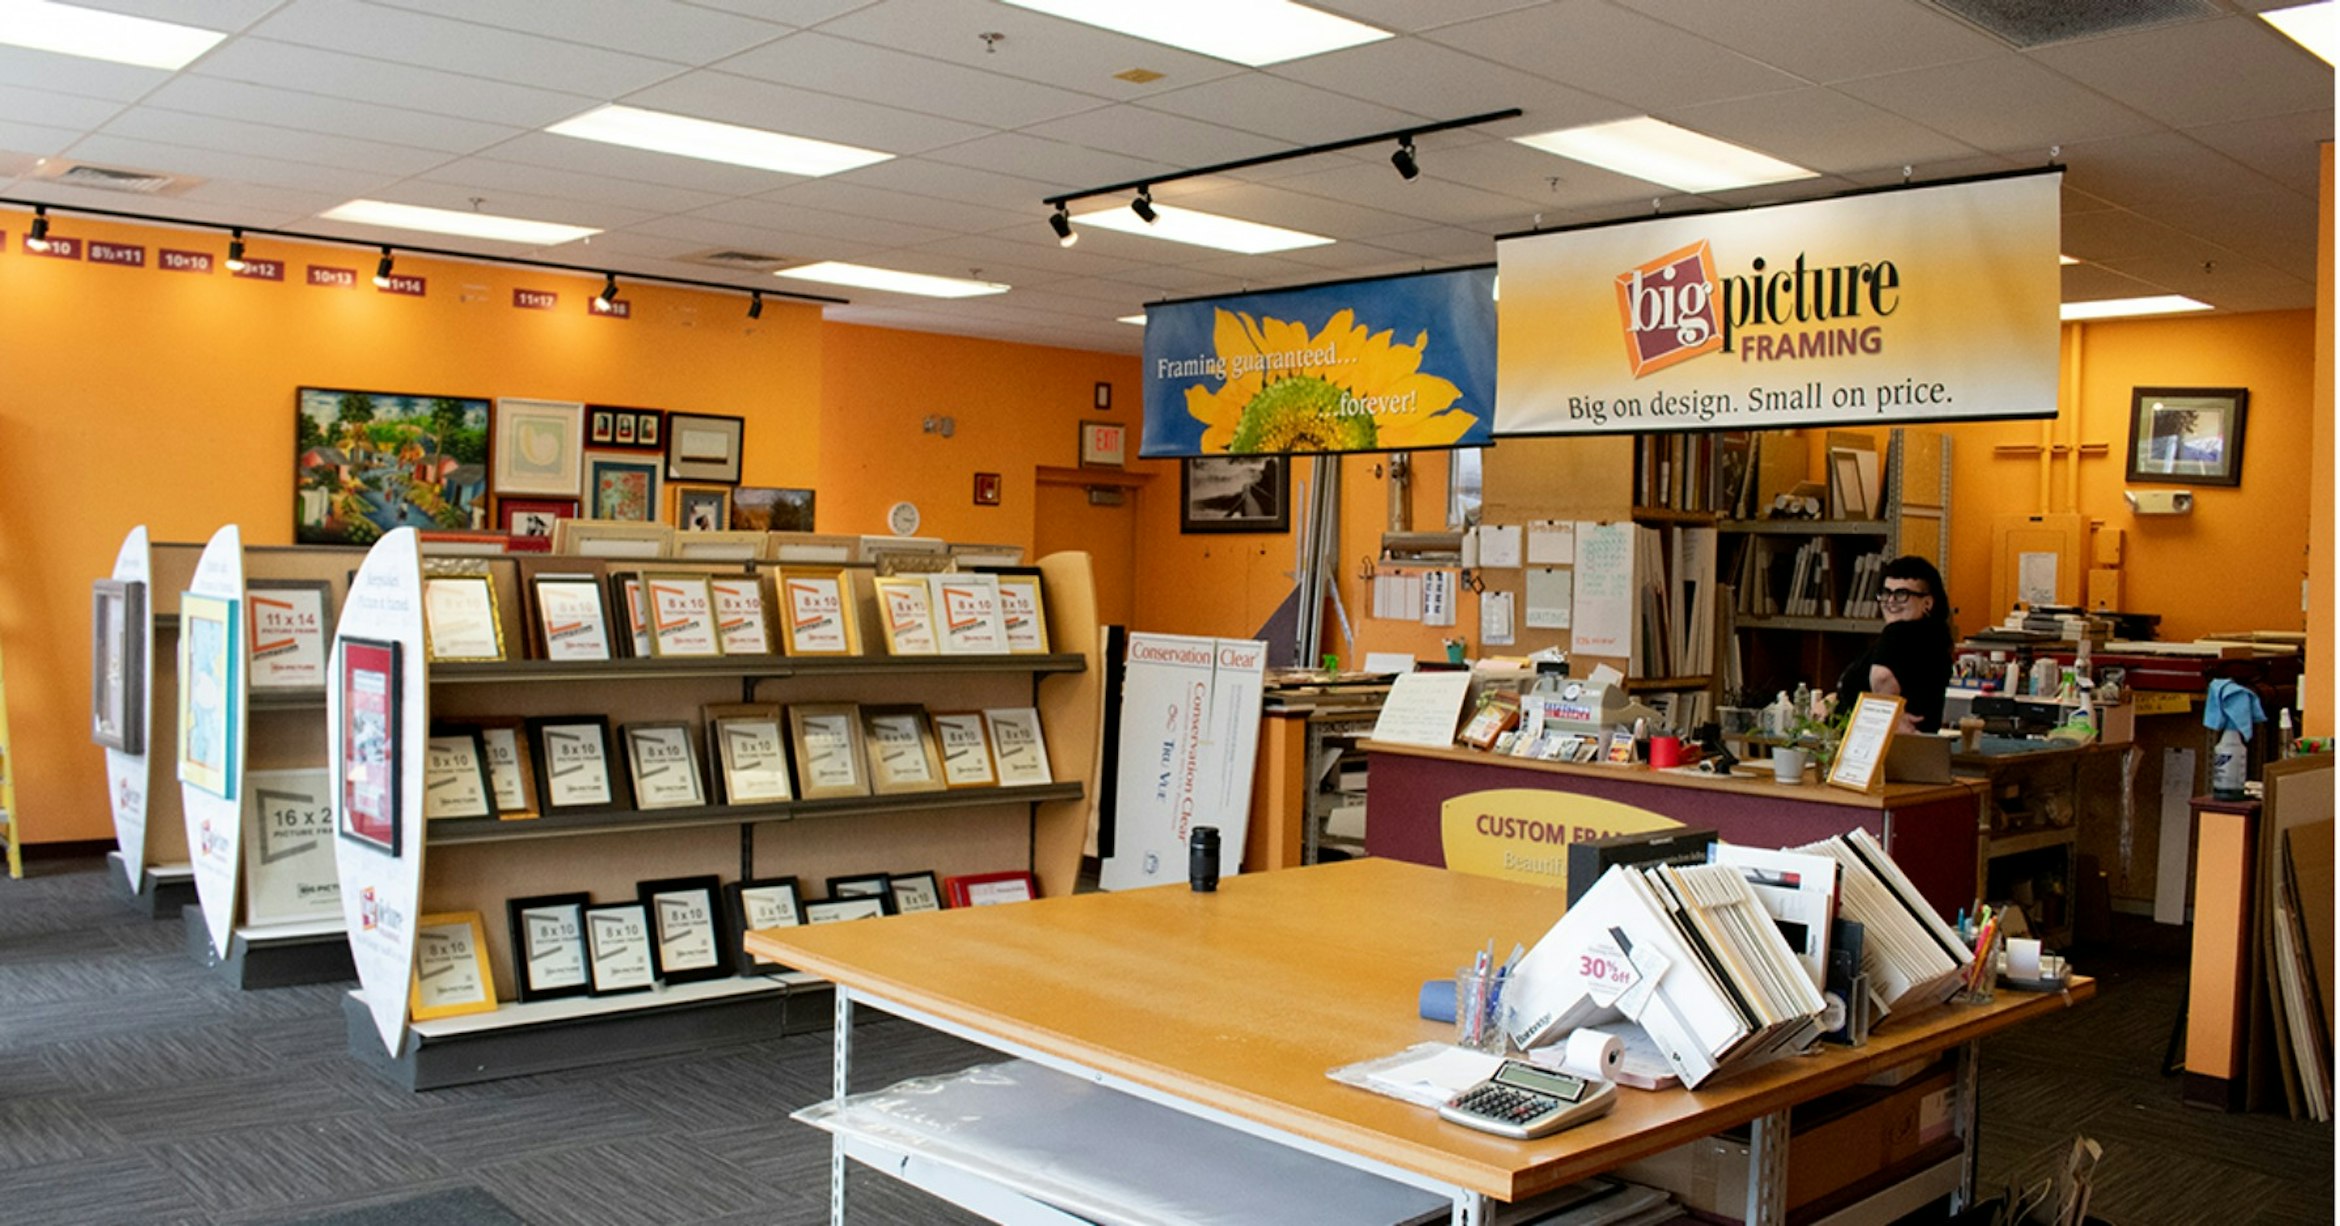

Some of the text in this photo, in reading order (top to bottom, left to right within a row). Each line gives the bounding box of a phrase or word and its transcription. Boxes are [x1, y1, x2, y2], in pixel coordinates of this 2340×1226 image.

[1626, 250, 1900, 355] big picture
[1741, 325, 1882, 363] FRAMING
[1157, 355, 1227, 381] Framing
[1568, 376, 1953, 426] Big on design. Small on price.
[1095, 428, 1120, 452] EXIT
[691, 598, 705, 609] 10
[747, 598, 760, 609] 10
[824, 597, 837, 607] 10
[266, 613, 315, 625] 11 x 14
[1132, 641, 1256, 668] Conservation Clear
[1184, 681, 1207, 794] Conservation
[562, 743, 595, 755] 8 x 10
[667, 745, 680, 756] 10
[758, 741, 771, 751] 10
[433, 755, 468, 767] 8 x 10
[274, 809, 297, 827] 16
[303, 813, 314, 825] x
[1178, 797, 1195, 843] Clear
[1477, 814, 1566, 846] CUSTOM
[672, 910, 679, 920] 8
[689, 909, 703, 919] 10
[541, 924, 575, 937] 8 x 10
[606, 925, 639, 937] 8 x 10
[429, 942, 466, 956] 8 x 10
[1579, 955, 1631, 984] 30% off
